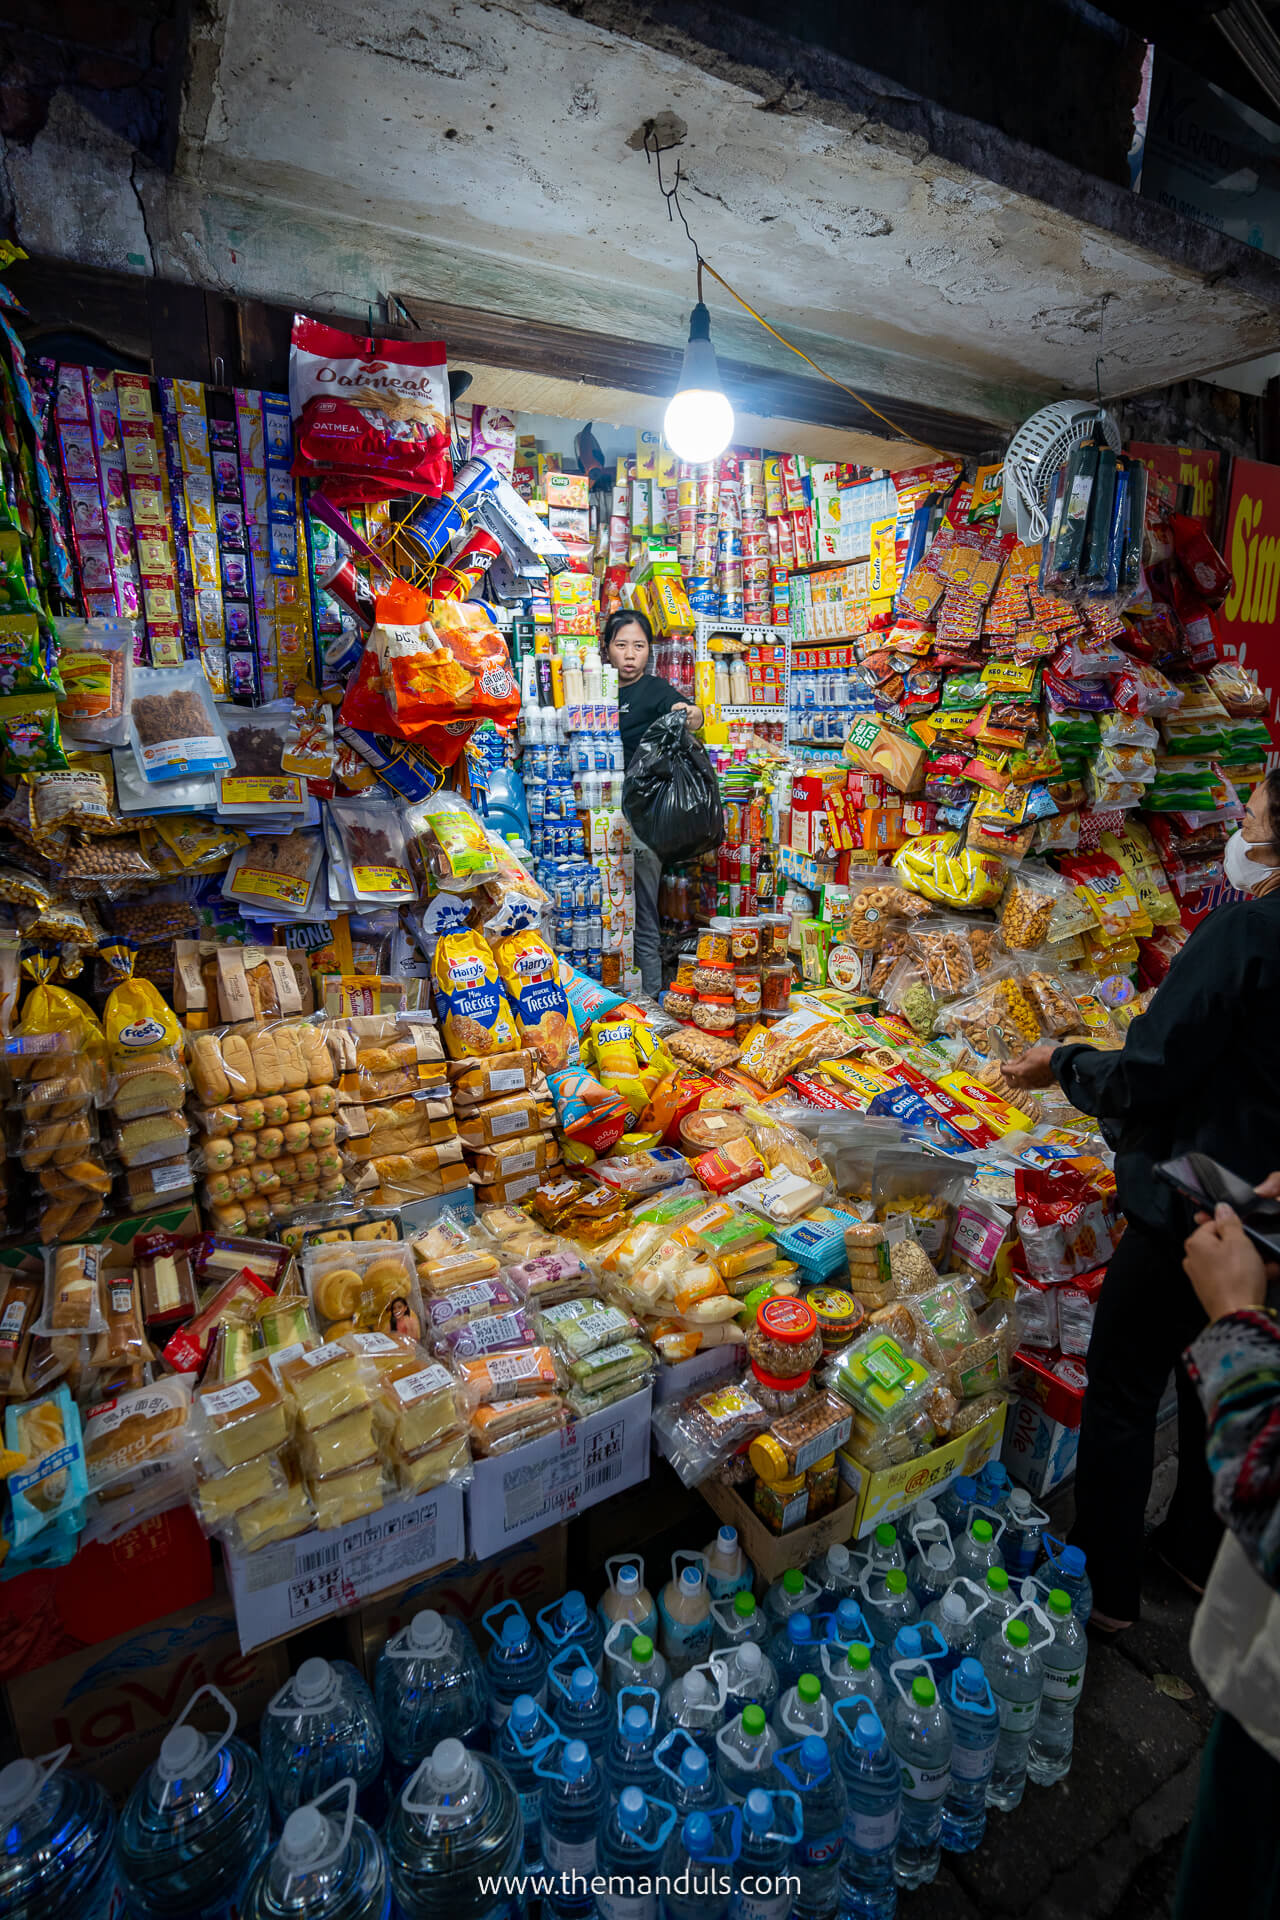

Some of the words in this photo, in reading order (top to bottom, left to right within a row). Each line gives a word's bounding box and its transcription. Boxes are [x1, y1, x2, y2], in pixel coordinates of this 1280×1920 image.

[316, 367, 432, 394] Oatmeal
[313, 422, 363, 434] OATMEAL
[1225, 494, 1280, 624] Sim
[792, 788, 808, 801] COSY
[454, 994, 497, 1014] TRESSÉE
[522, 992, 564, 1013] TRESSÉE
[598, 1025, 633, 1046] Staff
[838, 1064, 881, 1093] Custas
[893, 1095, 919, 1114] OREO
[936, 1092, 956, 1107] COSY
[959, 1225, 984, 1244] OCOP
[1063, 1365, 1084, 1386] Karo
